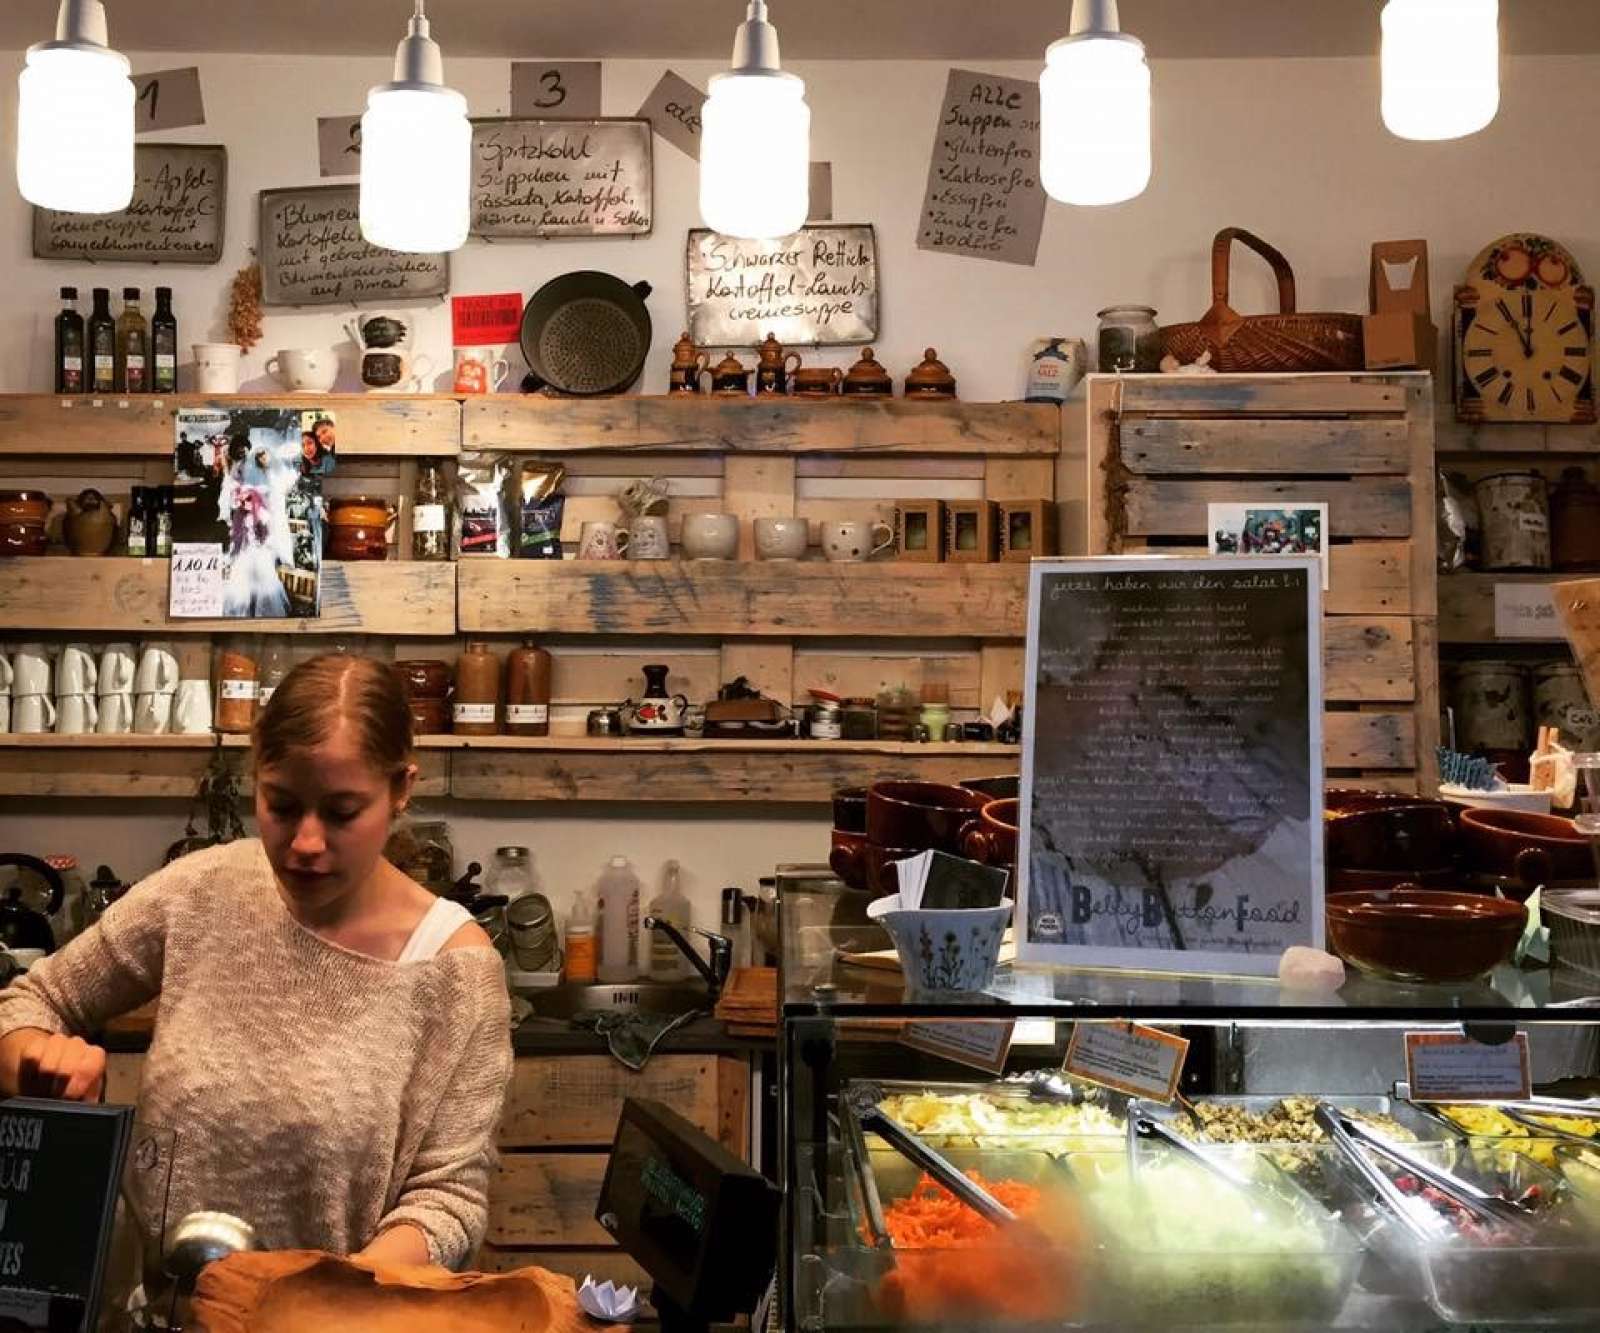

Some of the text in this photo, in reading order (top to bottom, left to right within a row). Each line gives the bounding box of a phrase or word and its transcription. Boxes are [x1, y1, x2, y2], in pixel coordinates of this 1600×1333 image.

[139, 79, 159, 121] 1
[533, 70, 566, 108] 3
[944, 105, 1013, 136] Suppen
[484, 133, 593, 172] Spitzkohl
[584, 160, 629, 182] mit
[812, 239, 871, 269] Rettich
[311, 281, 343, 297] auf
[1103, 575, 1152, 592] haben
[1192, 576, 1226, 590] den
